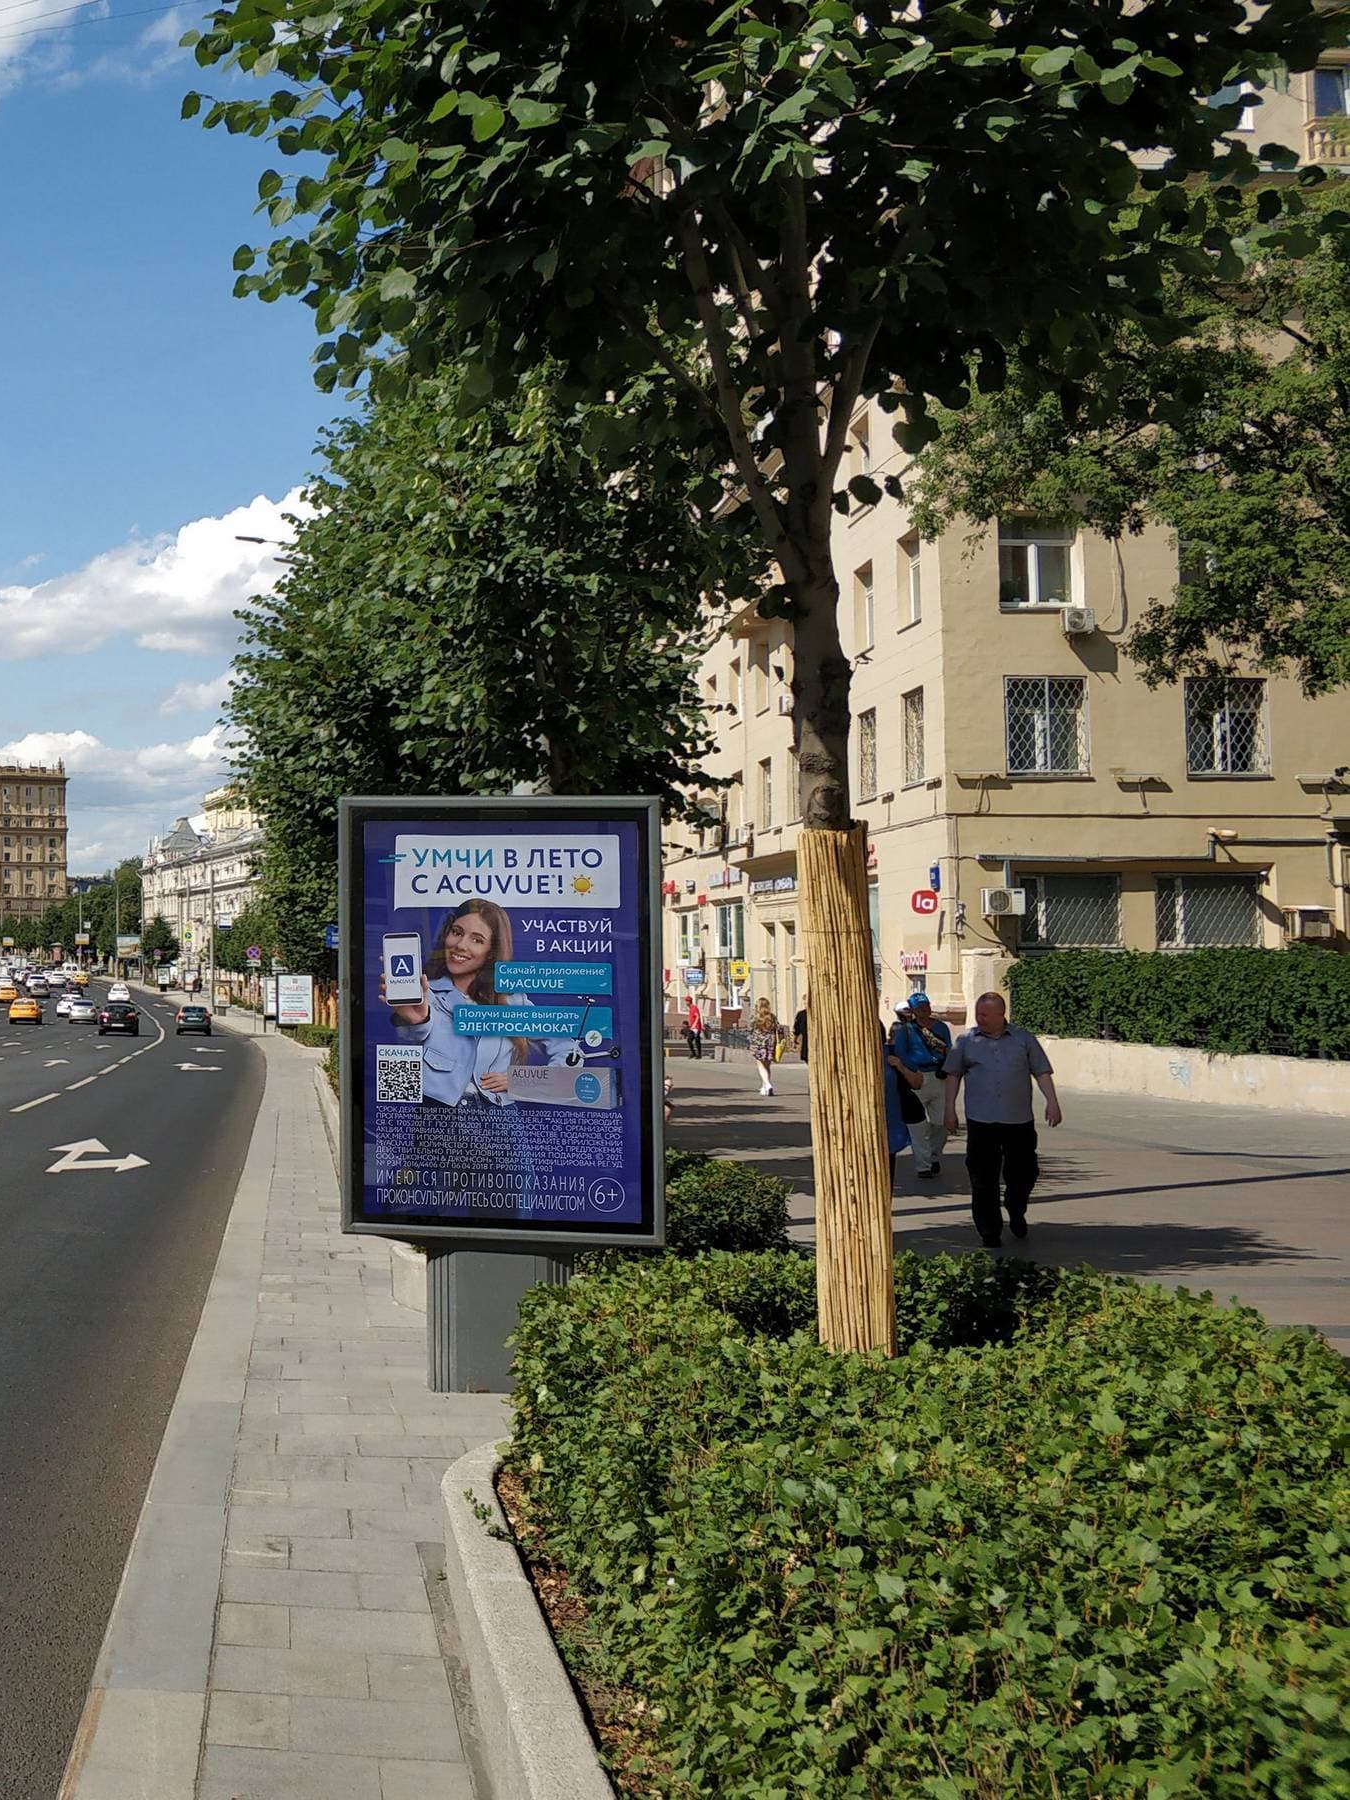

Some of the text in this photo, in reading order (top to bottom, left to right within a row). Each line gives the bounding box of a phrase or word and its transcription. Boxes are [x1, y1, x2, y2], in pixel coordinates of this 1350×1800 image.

[411, 848, 604, 869] УМЧИ В ЛЕТО
[411, 873, 429, 894] С
[915, 893, 935, 911] la
[522, 917, 613, 933] УЧАСТВУЙ
[536, 939, 613, 955] В АКЦИИ
[395, 958, 410, 974] A
[499, 964, 536, 975] Скачай
[499, 978, 565, 990] MyACUVUE
[458, 1008, 580, 1021] Получи шанс выиграть
[378, 1049, 421, 1058] СКАЧАТЬ
[512, 1068, 550, 1080] ACUVUE
[376, 1169, 586, 1191] ИМЕЮТСЯ ПРОТИВОПОКАЗАНИЯ
[376, 1188, 586, 1211] ПРОКОНСУЛЬТИРУЙТЕСЬ СО СПЕЦИАЛИСТОМ
[594, 1184, 619, 1205] 6+
